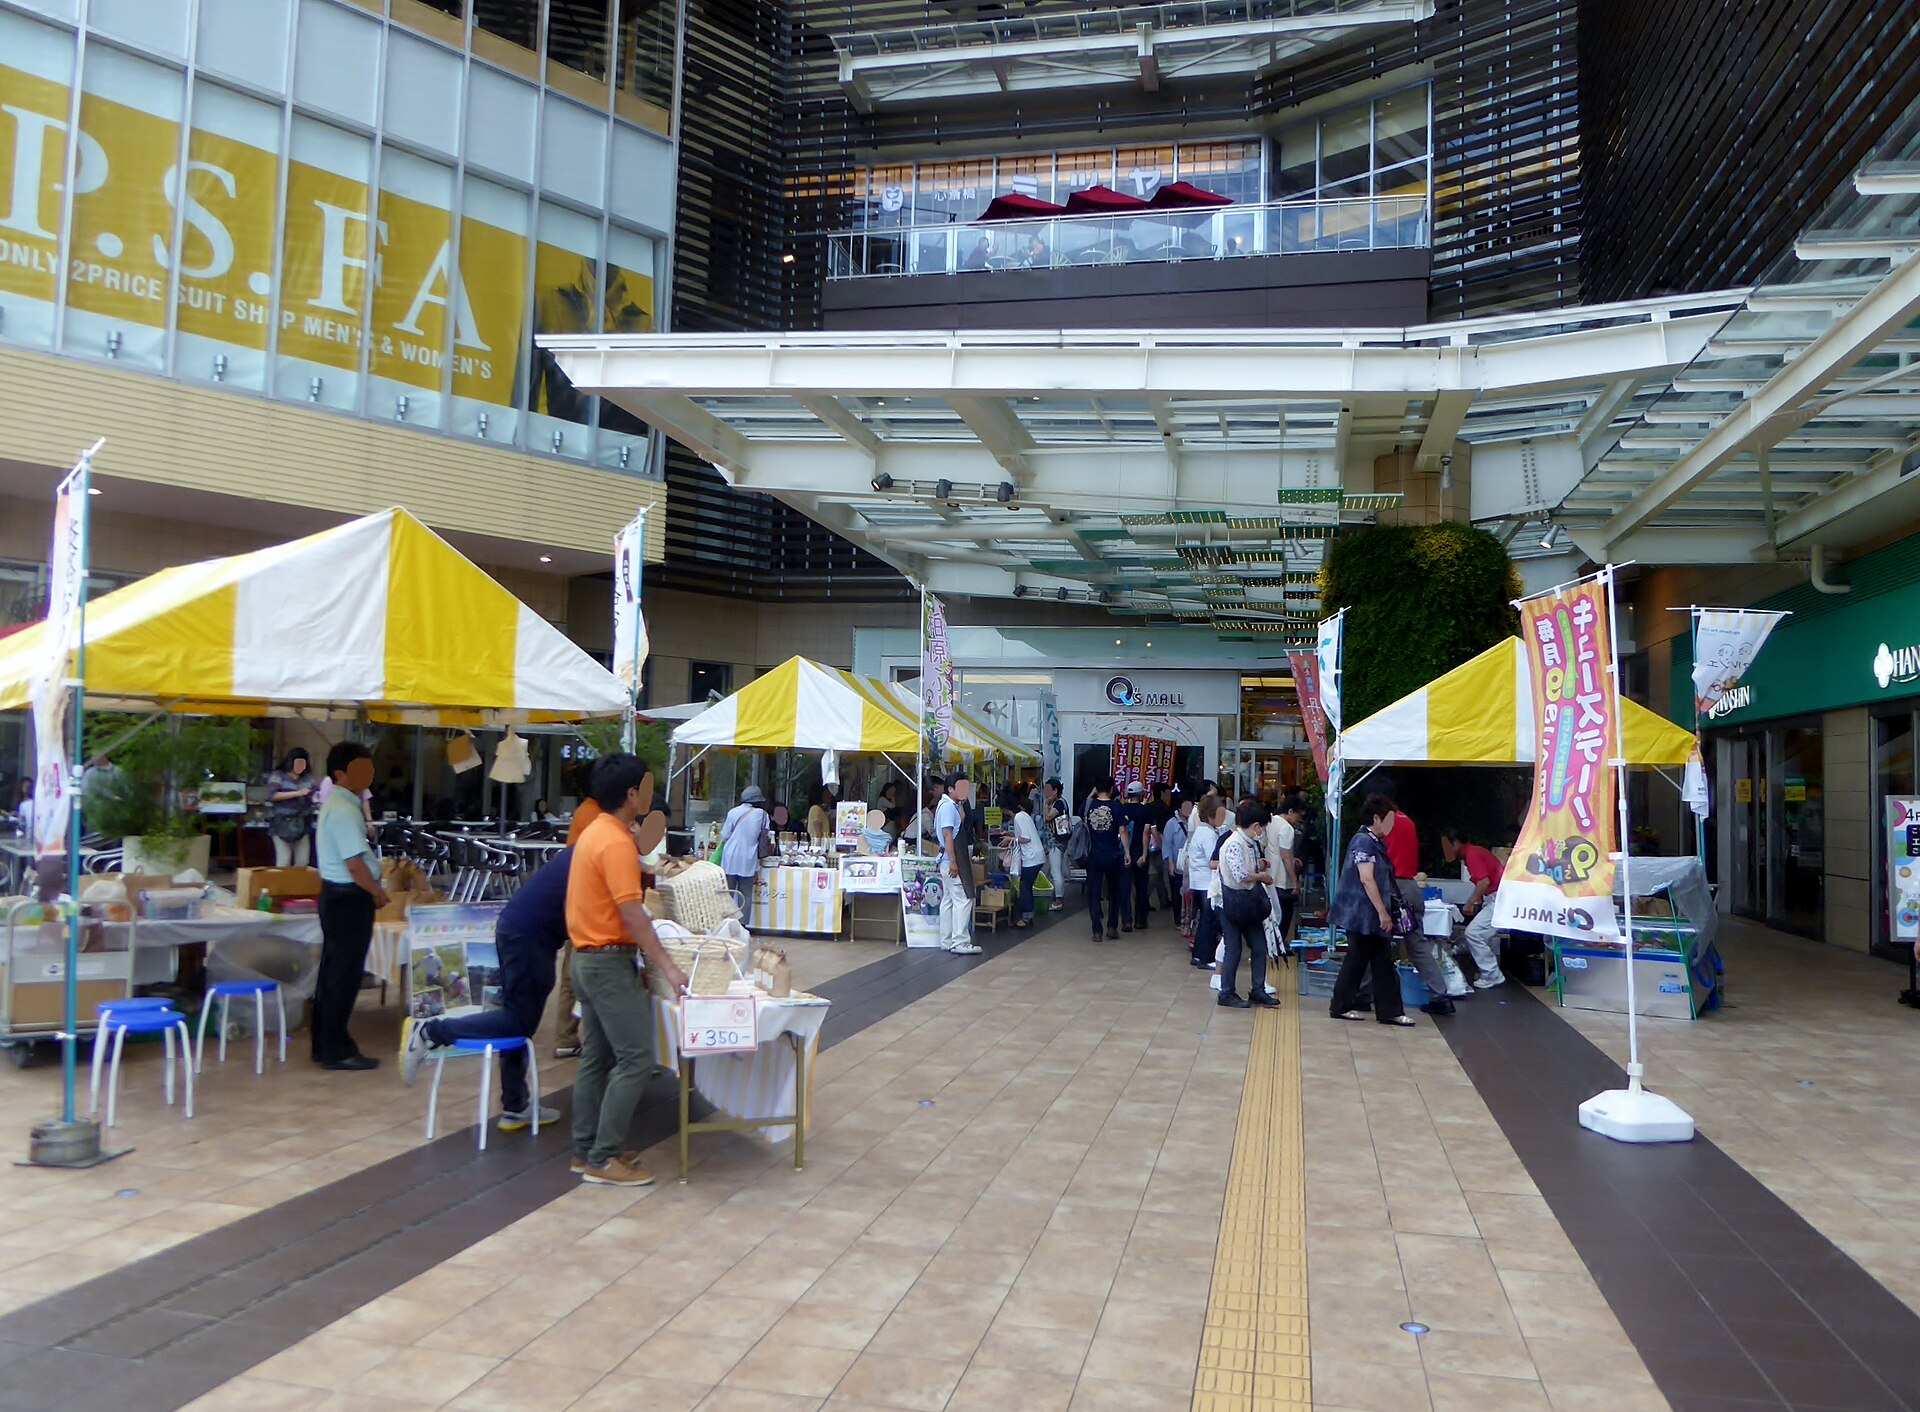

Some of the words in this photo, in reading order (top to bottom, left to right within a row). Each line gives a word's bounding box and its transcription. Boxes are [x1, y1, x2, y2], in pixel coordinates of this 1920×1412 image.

[0, 238, 60, 274] ONLY
[71, 259, 162, 301] 2PRICE
[177, 284, 227, 314] SUIT
[234, 299, 296, 330] SHP
[380, 335, 394, 356] &
[1146, 693, 1185, 706] MALL
